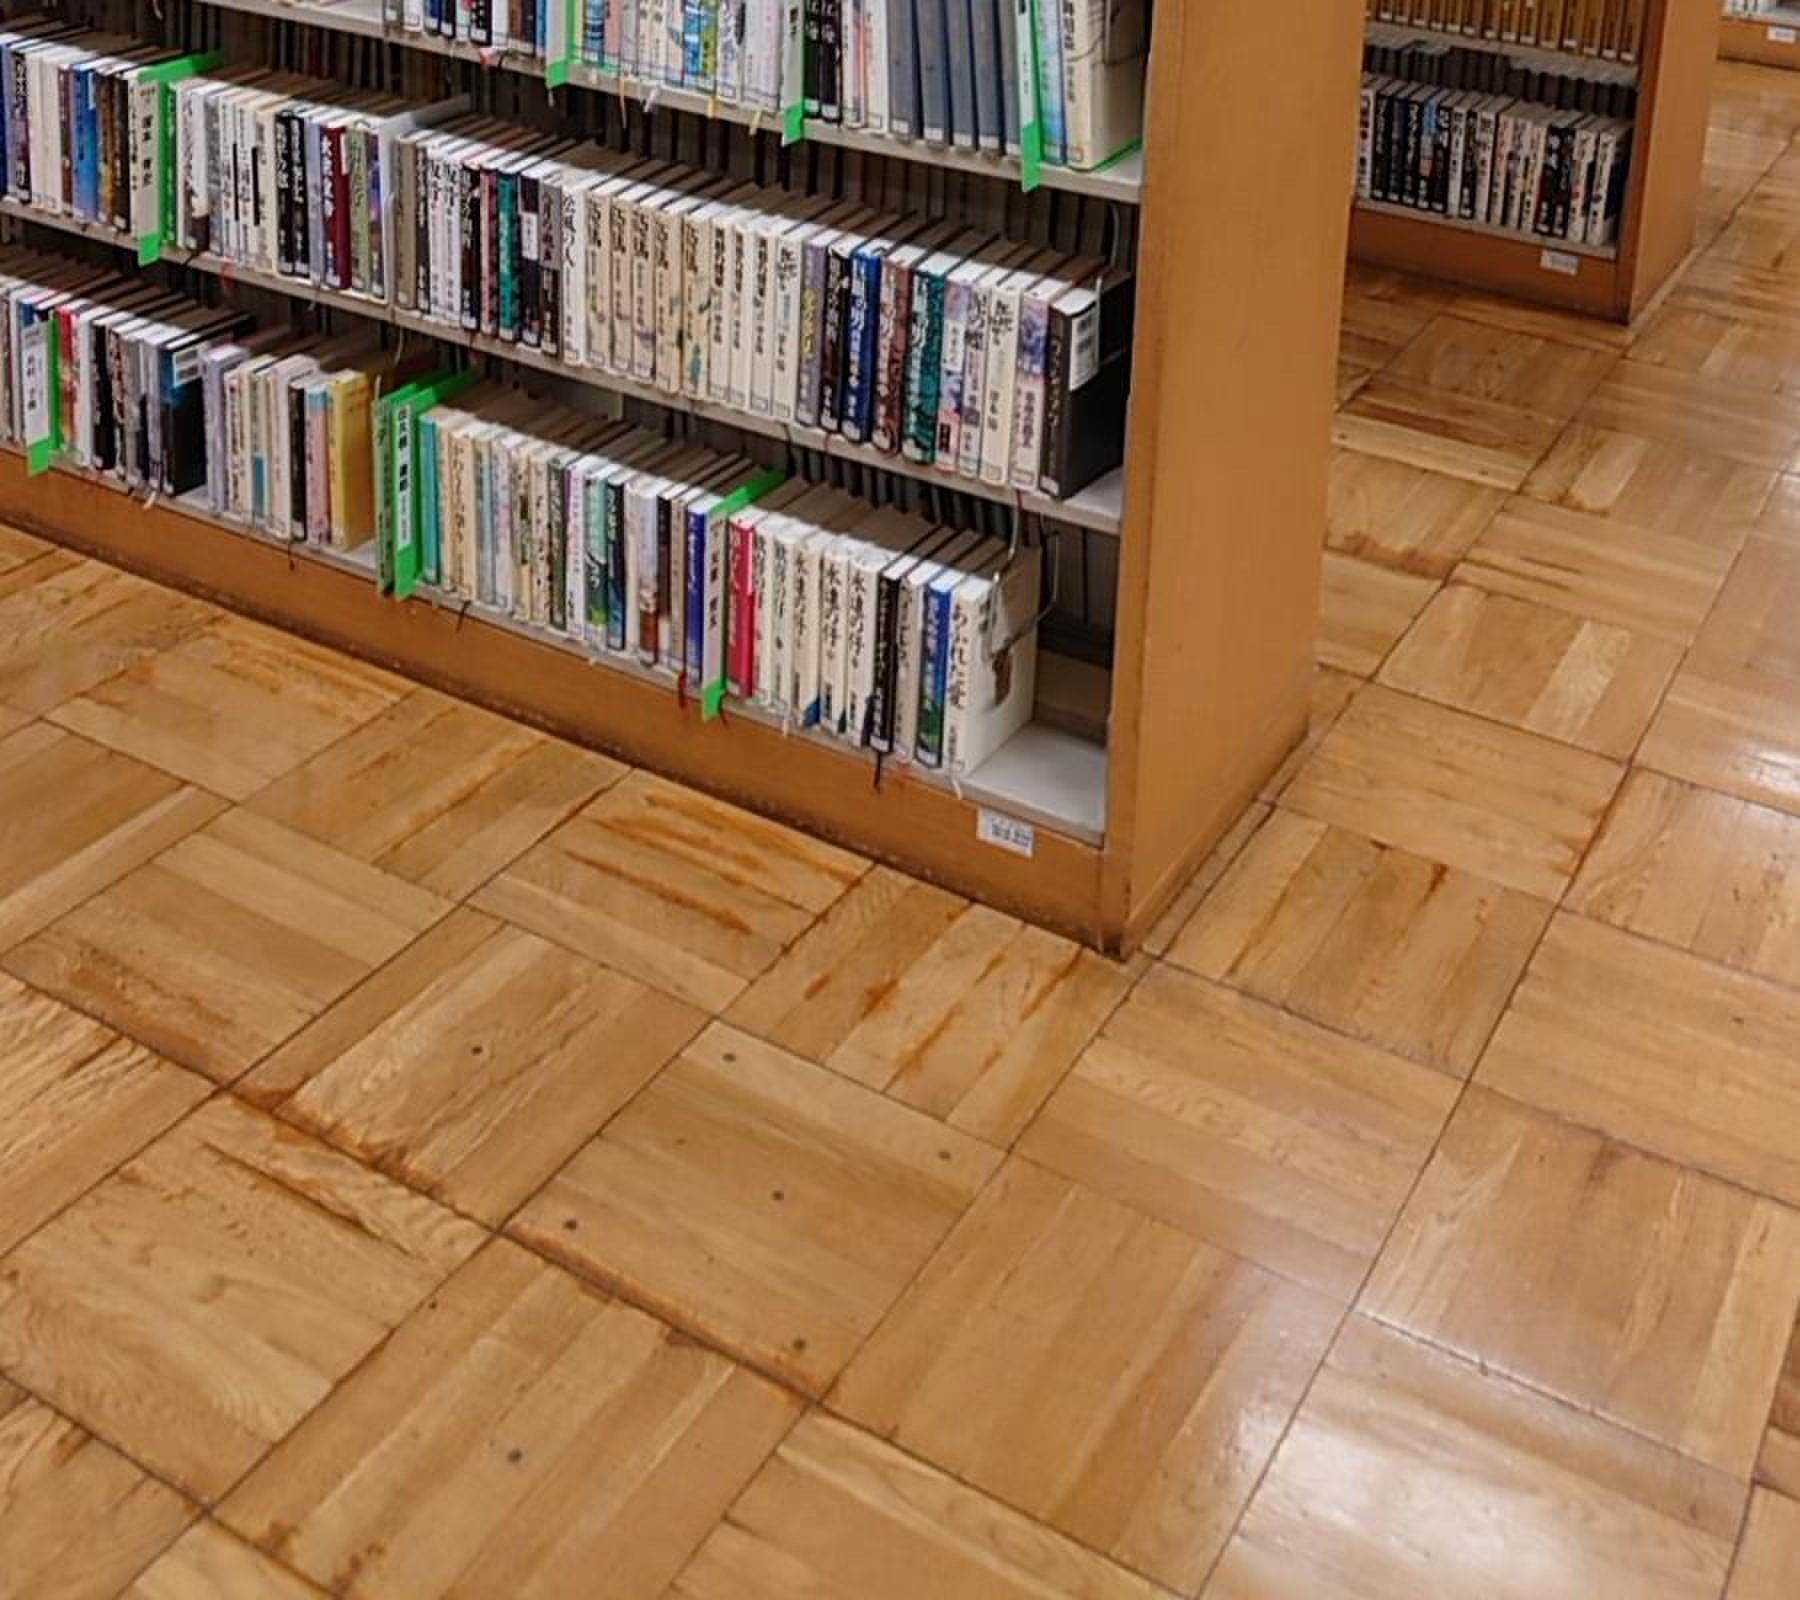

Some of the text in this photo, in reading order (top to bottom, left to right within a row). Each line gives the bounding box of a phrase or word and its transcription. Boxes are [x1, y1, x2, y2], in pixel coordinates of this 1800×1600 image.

[950, 603, 969, 711] あふれた愛
